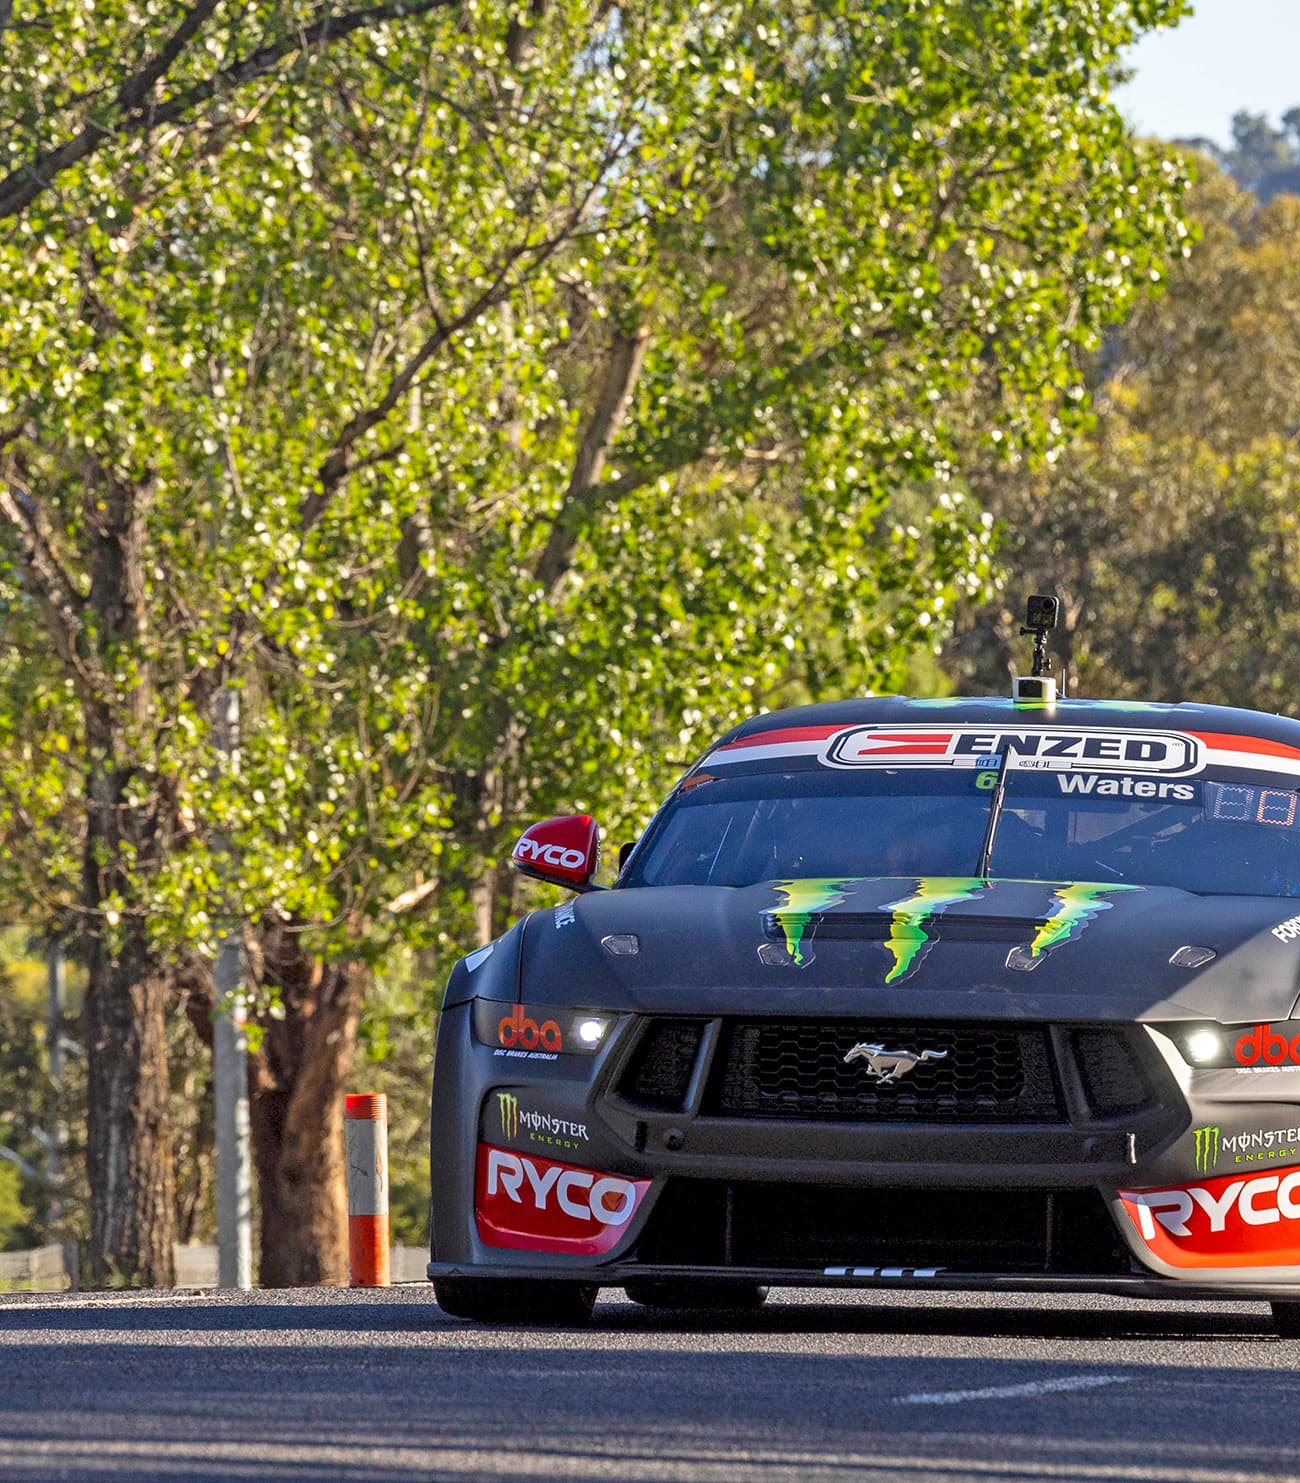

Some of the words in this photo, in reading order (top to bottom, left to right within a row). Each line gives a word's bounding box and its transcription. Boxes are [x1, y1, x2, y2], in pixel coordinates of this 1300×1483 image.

[953, 733, 1168, 763] ENZED
[975, 771, 998, 790] 6
[1057, 774, 1194, 800] Waters
[512, 838, 585, 869] RYCO
[498, 1004, 562, 1051] dba
[530, 1132, 579, 1149] ENERGY
[1234, 1149, 1296, 1163] ENERGY
[488, 1150, 636, 1226] RYCO
